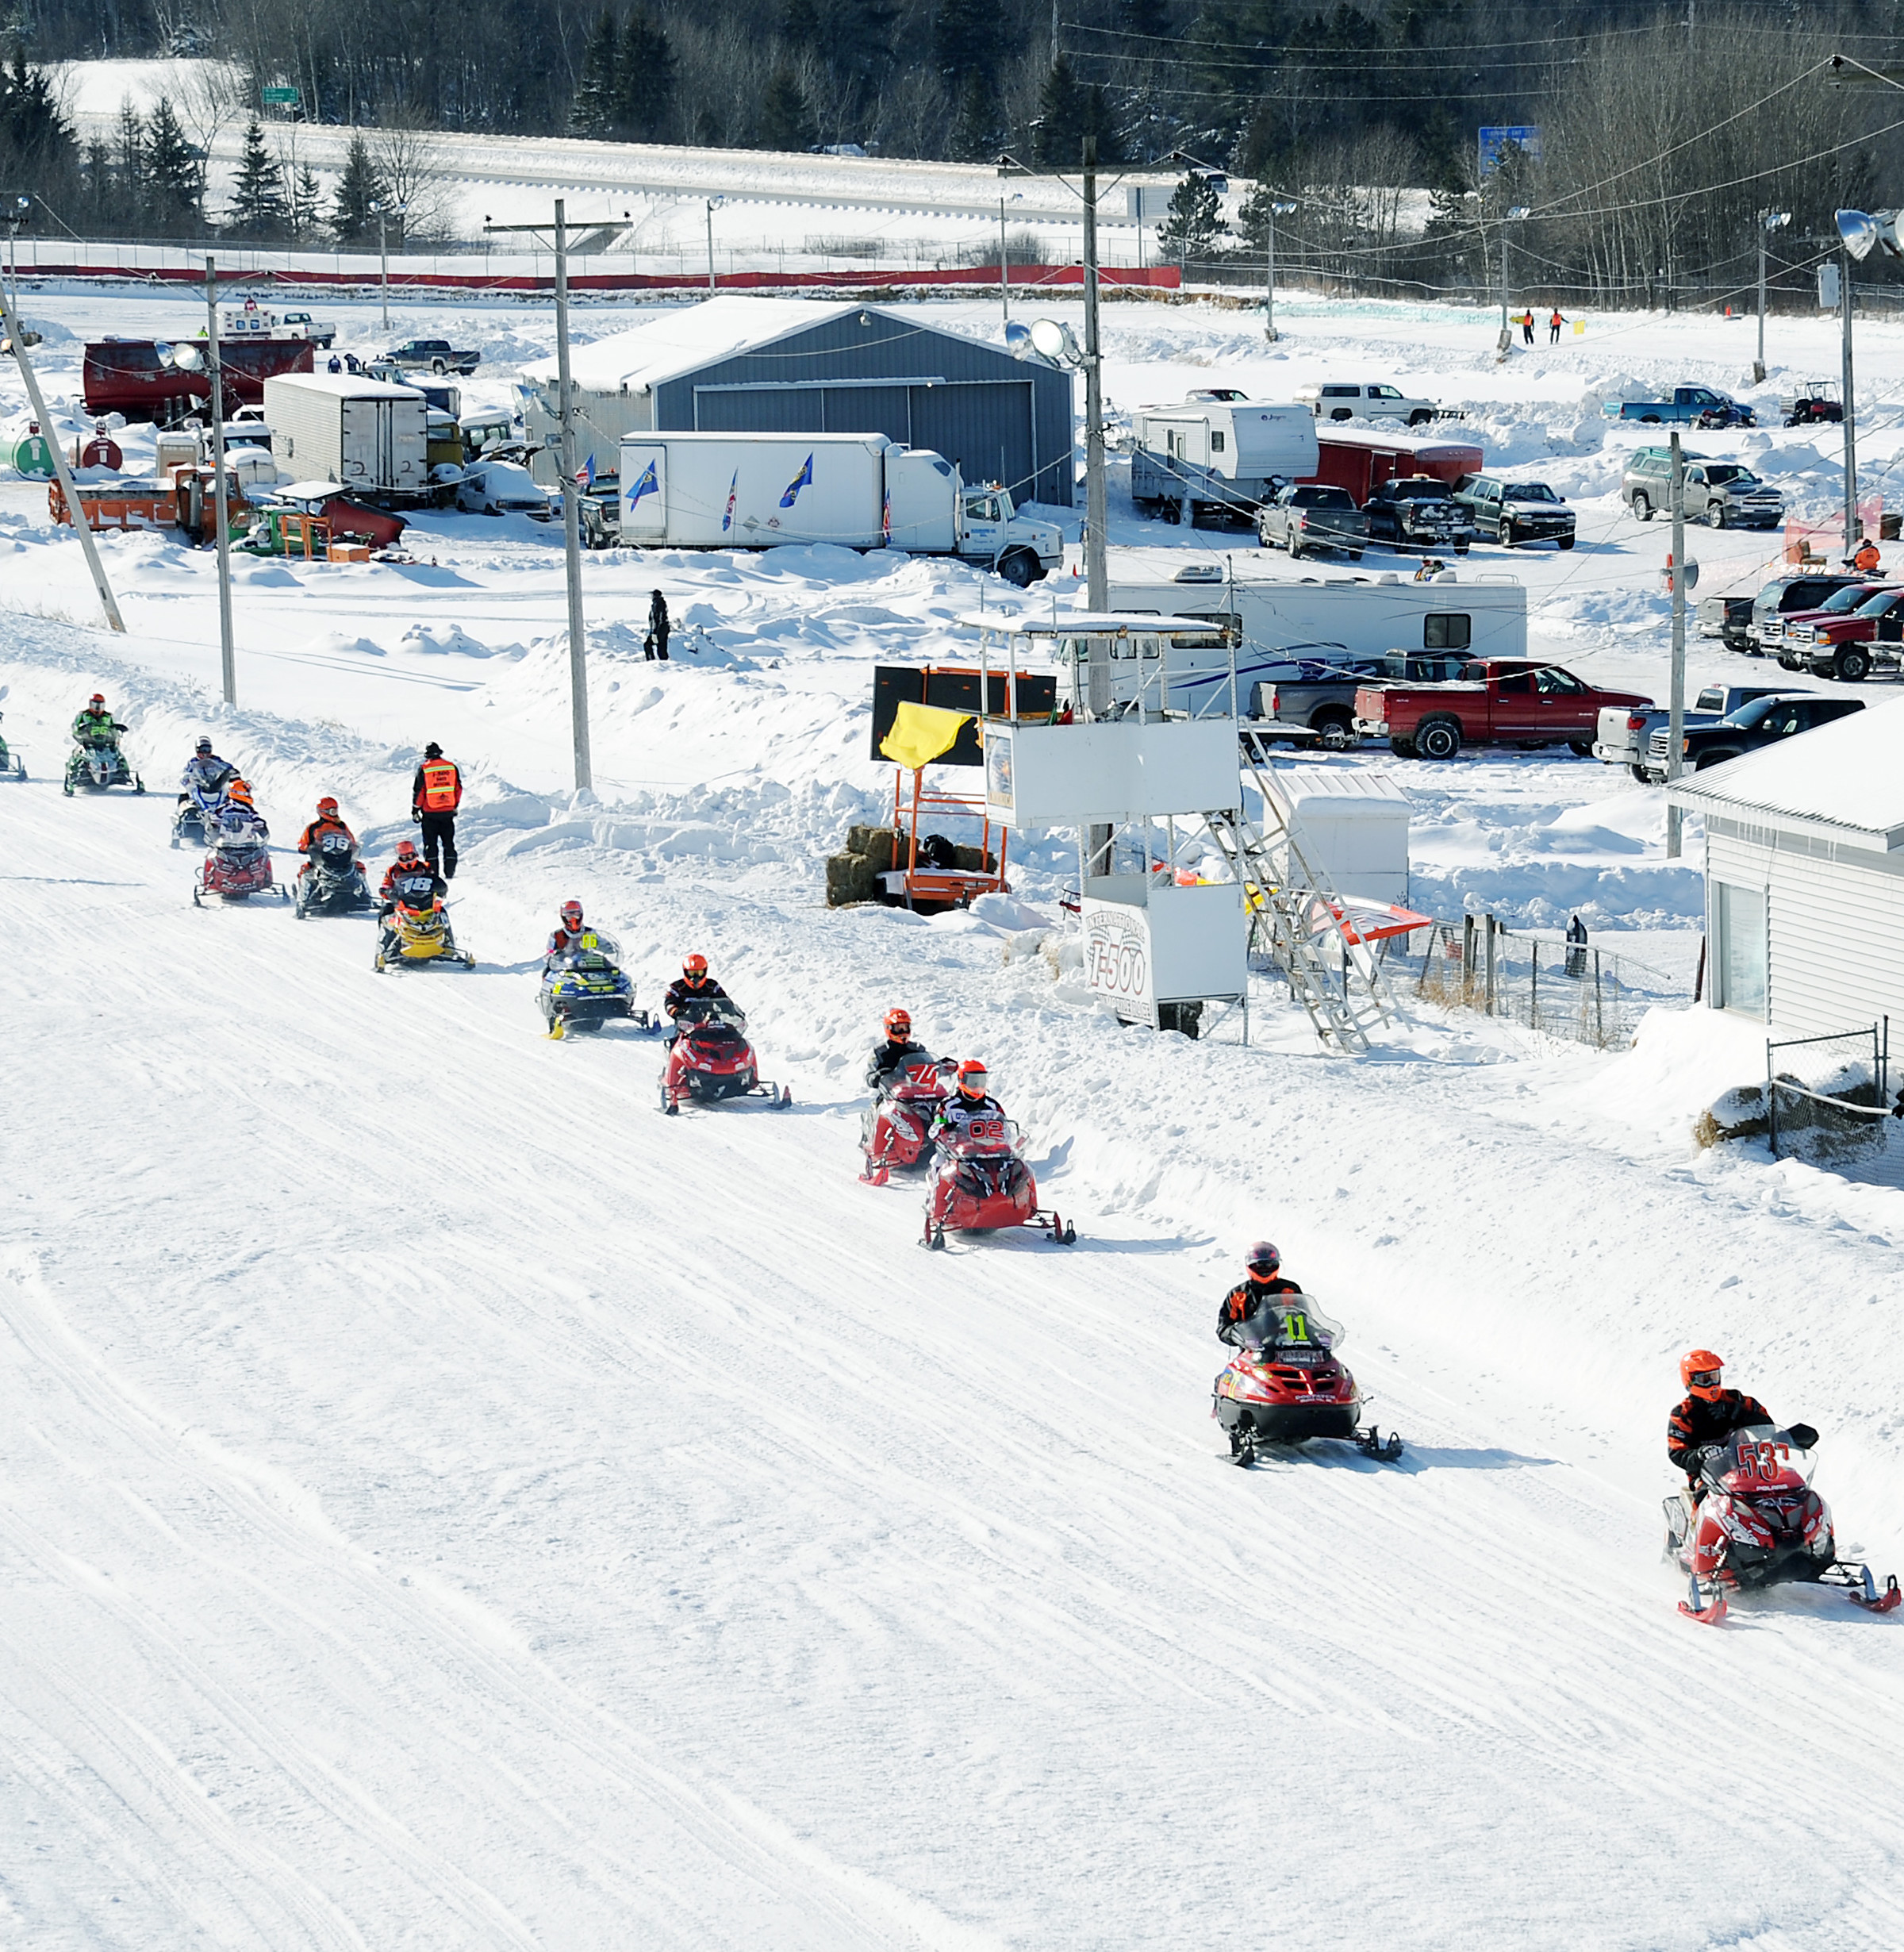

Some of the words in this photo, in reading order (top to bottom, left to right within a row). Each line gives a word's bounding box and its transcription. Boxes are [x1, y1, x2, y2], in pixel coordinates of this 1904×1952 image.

[401, 460, 415, 473] 2
[401, 877, 433, 893] 18
[1086, 910, 1146, 943] INTERNATIONAL
[1091, 940, 1146, 995] I-500
[905, 1064, 939, 1092] 74
[969, 1120, 1004, 1139] 02
[1284, 1313, 1308, 1341] 11
